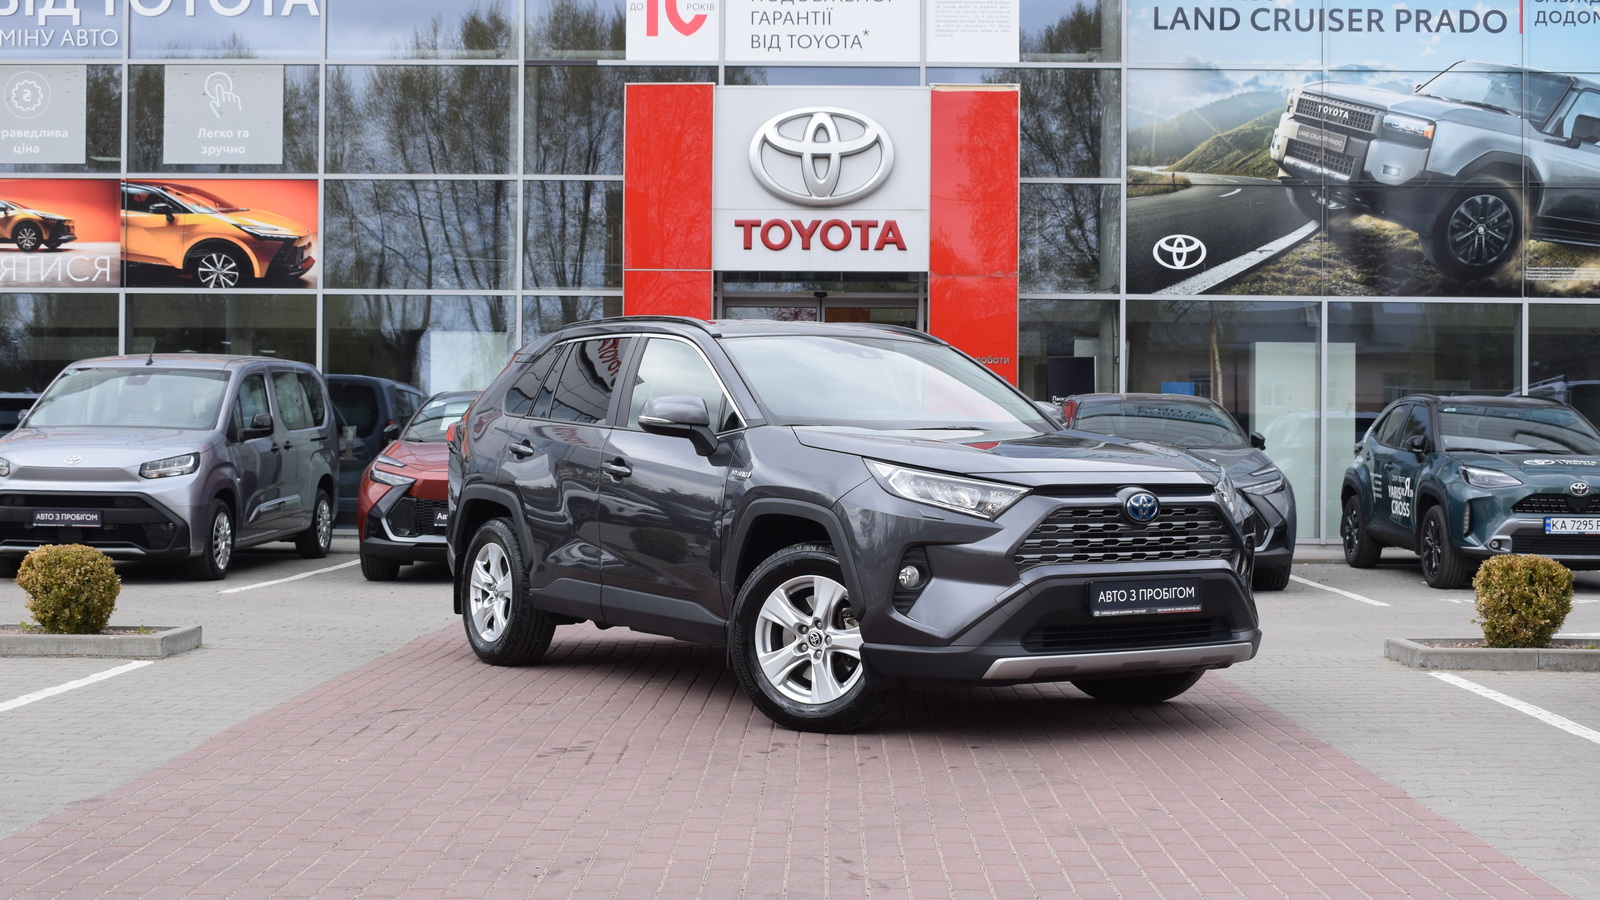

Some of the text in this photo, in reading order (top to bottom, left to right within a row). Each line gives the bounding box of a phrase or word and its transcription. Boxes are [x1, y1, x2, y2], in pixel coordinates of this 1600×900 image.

[686, 3, 715, 11] РОКІВ
[750, 7, 832, 26] ГАРАНТІЇ
[1153, 6, 1508, 34] LAND CRUISER PRADO
[60, 28, 119, 47] АВТО
[750, 34, 782, 52] ВІД
[1317, 104, 1349, 120] TOYOTA
[1, 129, 69, 140] раведлива
[197, 127, 250, 138] Легко та
[13, 142, 40, 155] ціна
[200, 146, 246, 157] зручно
[734, 218, 907, 252] TOYOTA
[1387, 485, 1402, 500] YARIS
[1391, 499, 1411, 518] CROSS
[36, 513, 54, 521] АВТО
[61, 513, 98, 521] ПРОБІГОМ
[1552, 519, 1567, 530] KA
[1570, 519, 1594, 530] 7295
[1098, 589, 1127, 603] АВТО
[1139, 586, 1195, 601] ПРОБІГОМ
